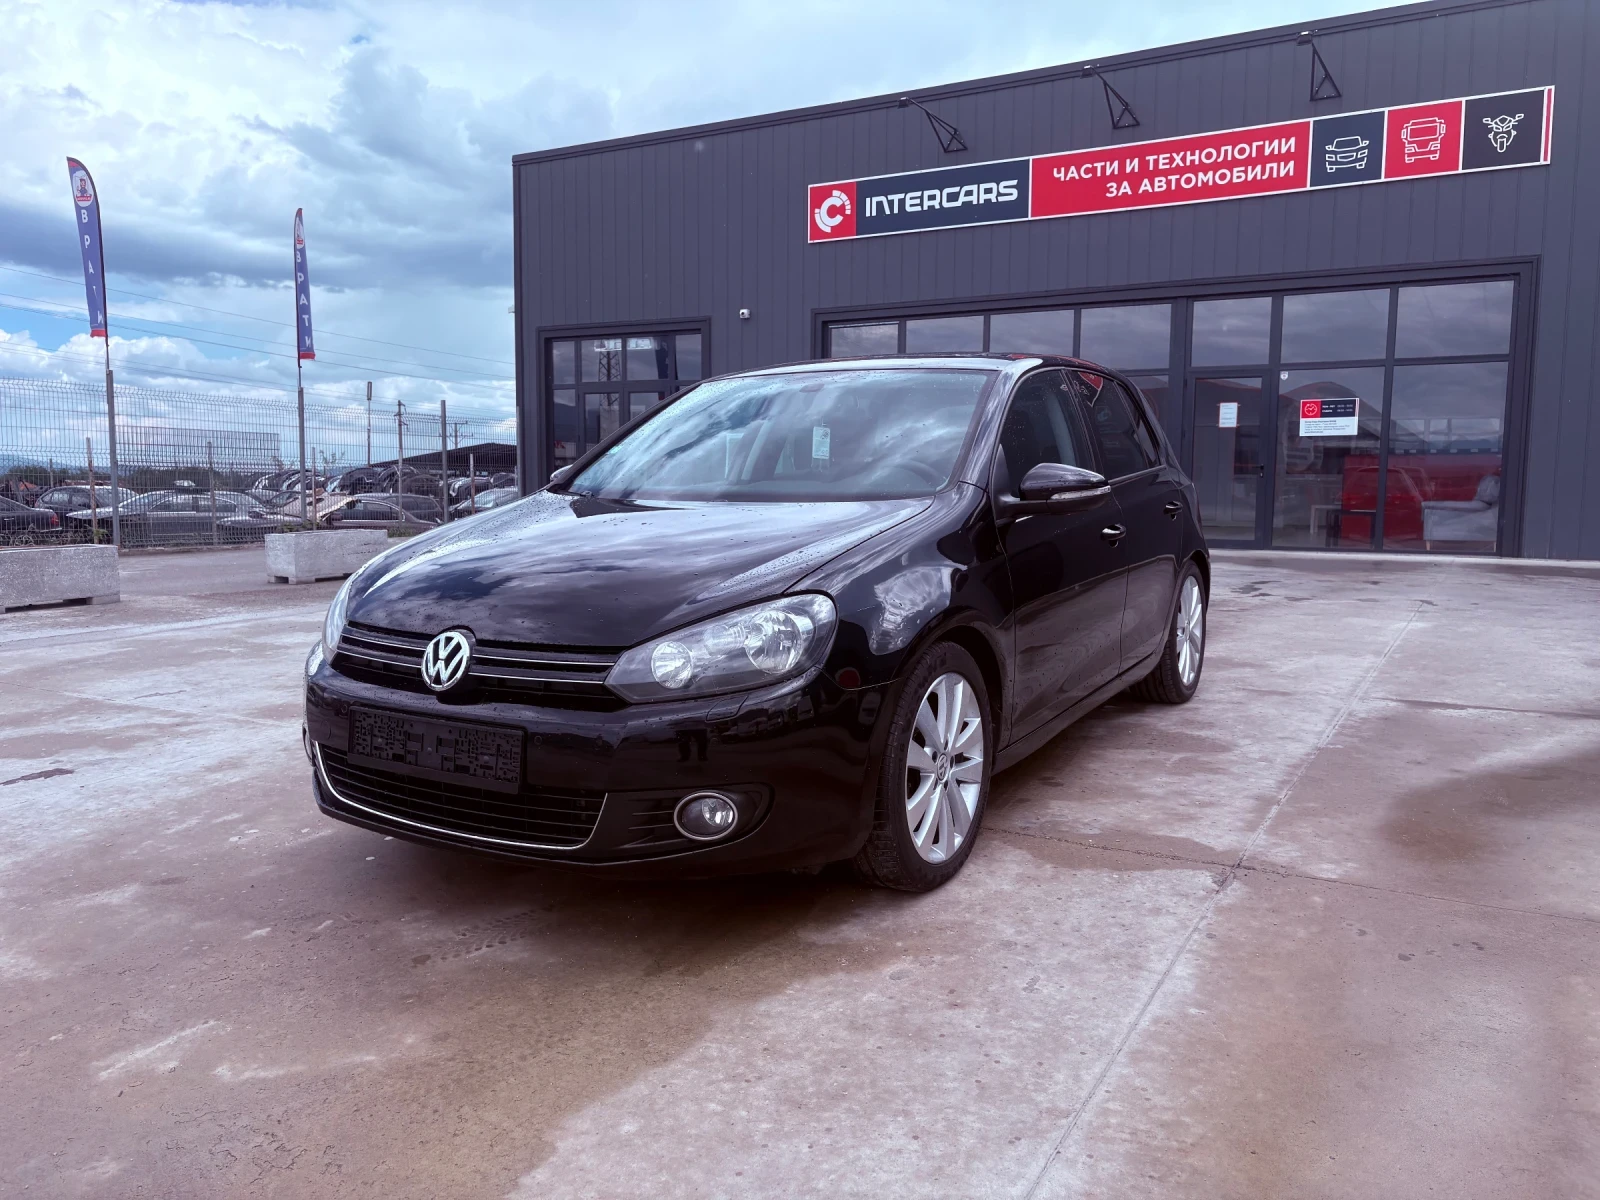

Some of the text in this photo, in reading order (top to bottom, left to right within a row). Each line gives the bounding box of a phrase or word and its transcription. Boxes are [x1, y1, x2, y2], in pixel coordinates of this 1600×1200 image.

[1053, 136, 1296, 182] ЧАСТИ И ТЕХНОЛОГИИ
[1105, 160, 1295, 198] ЗА АВТОМОБИЛИ
[865, 180, 1018, 217] INTERCARS
